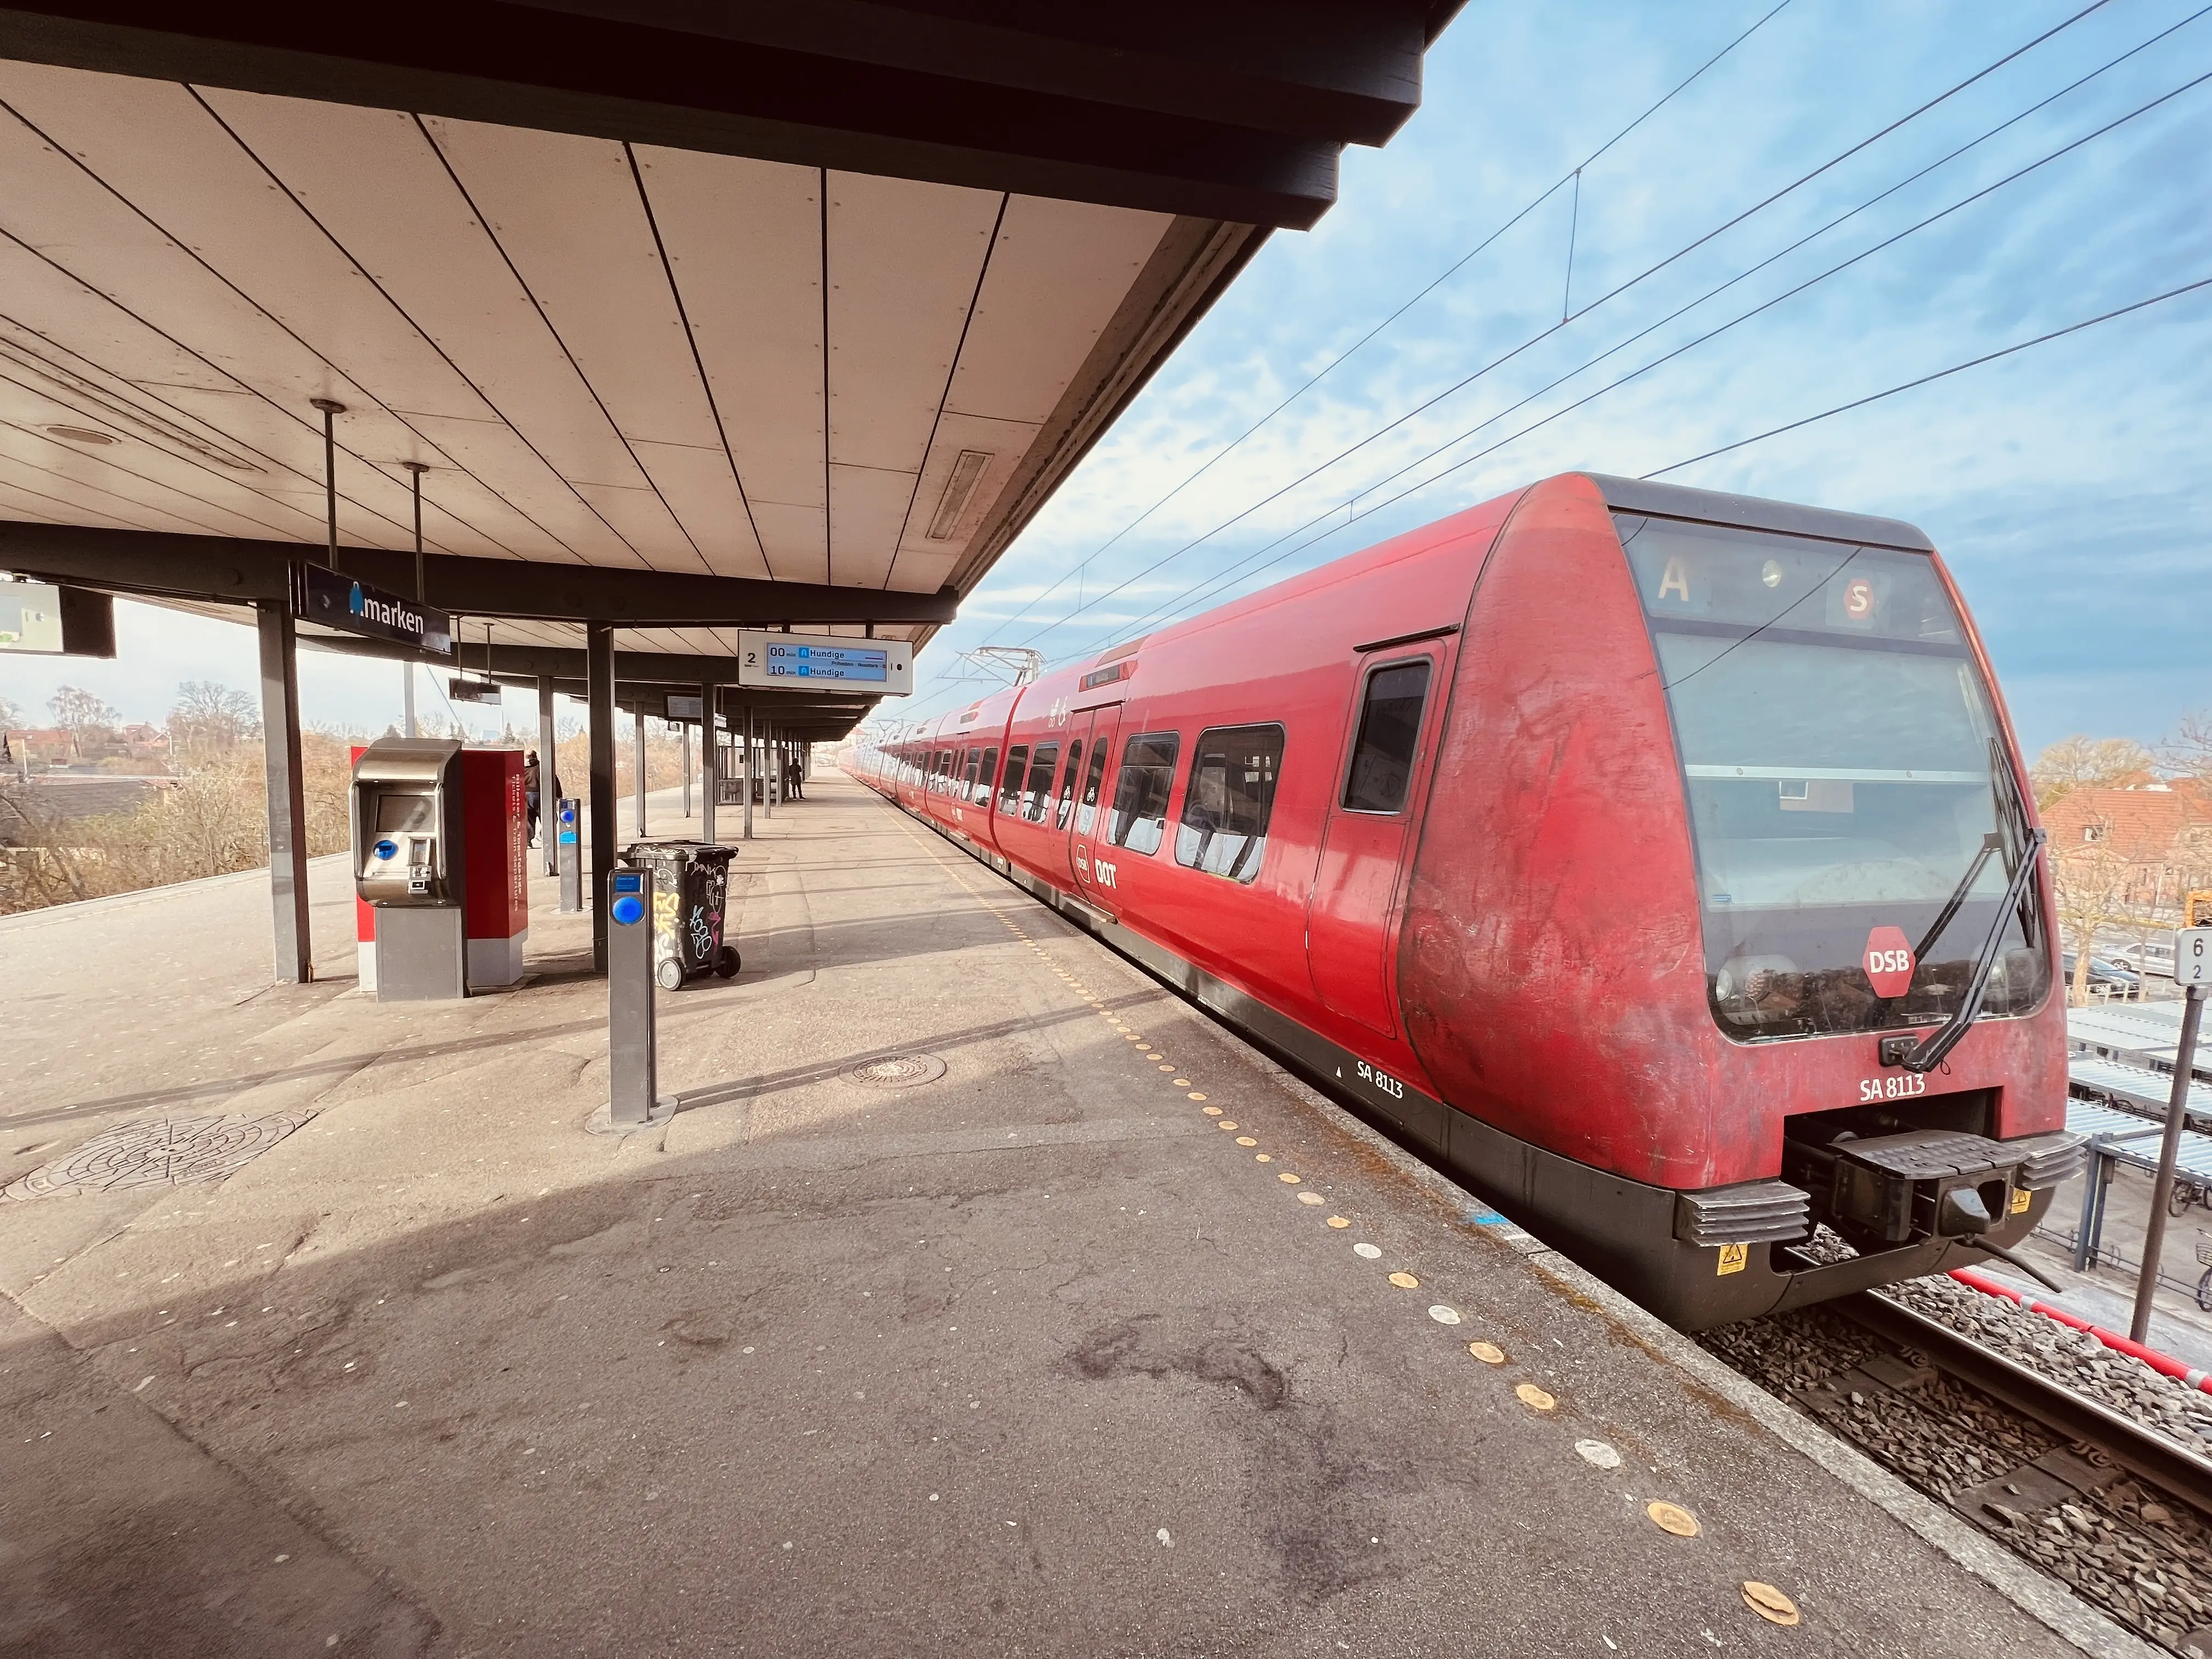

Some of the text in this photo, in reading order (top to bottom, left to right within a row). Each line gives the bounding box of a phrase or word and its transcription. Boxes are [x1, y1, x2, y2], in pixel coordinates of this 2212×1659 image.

[1658, 556, 1690, 602] A
[1850, 585, 1867, 612] S
[748, 652, 755, 663] 2
[770, 647, 785, 657] 00
[810, 650, 844, 659] Hundige
[771, 665, 785, 675] 10
[810, 668, 844, 677] Hundige
[1095, 858, 1117, 889] DOT
[2193, 938, 2204, 957] 6
[1869, 950, 1910, 974] DSB
[2193, 964, 2202, 979] 2
[1357, 1060, 1403, 1099] SA 8113
[1860, 1073, 1926, 1102] SA 8113
